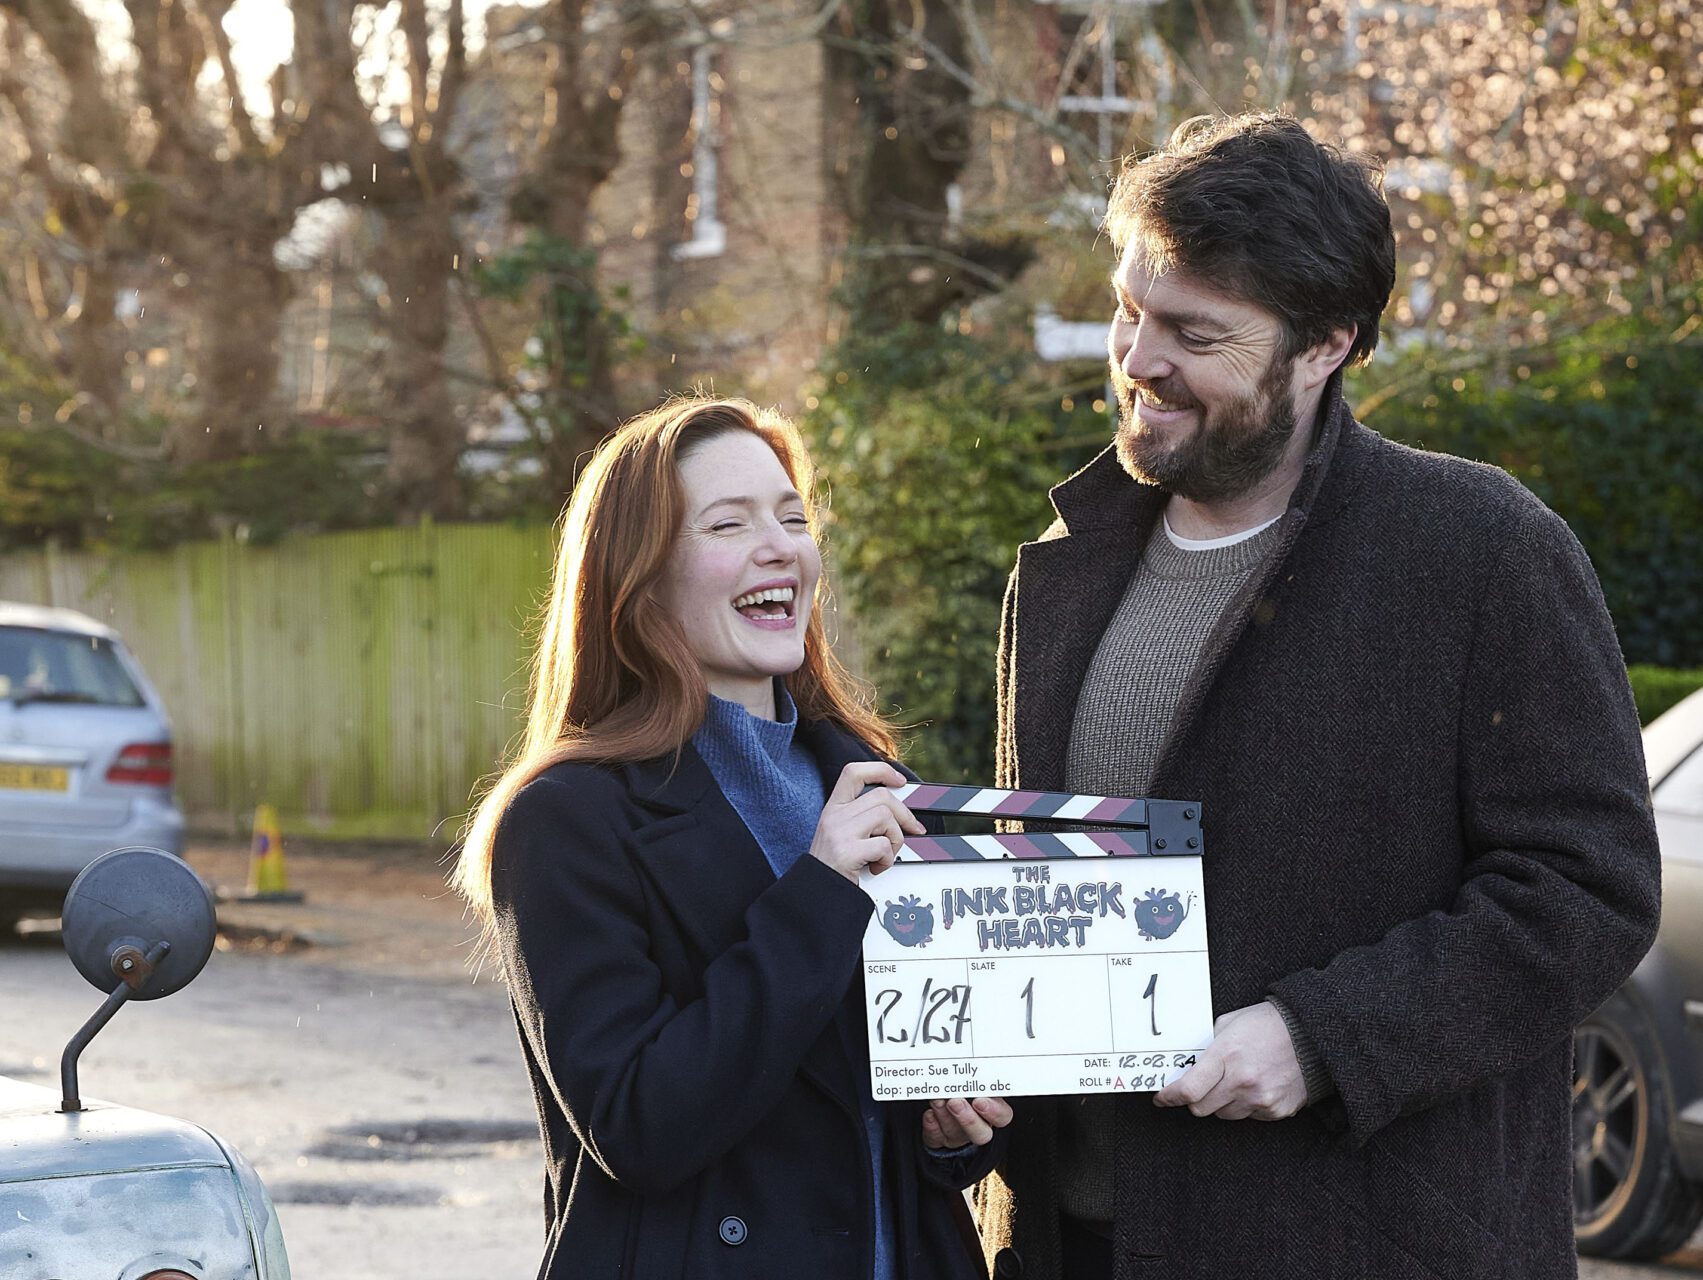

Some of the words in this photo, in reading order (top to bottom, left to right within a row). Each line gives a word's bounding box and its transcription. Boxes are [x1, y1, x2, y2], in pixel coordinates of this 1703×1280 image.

[1012, 865, 1050, 884] THE
[942, 887, 1009, 930] INK
[1013, 882, 1126, 919] BLACK
[977, 916, 1093, 952] HEART
[868, 965, 897, 974] SCENE
[971, 962, 996, 971] SLATE
[1111, 958, 1132, 966] TAKE
[875, 978, 972, 1047] 2/27
[1020, 977, 1036, 1039] 1
[1142, 974, 1162, 1036] 1
[875, 1066, 924, 1078] Director:
[928, 1065, 949, 1076] Sue
[952, 1063, 978, 1077] Tully
[1084, 1058, 1111, 1068] DATE:
[876, 1085, 902, 1098] dop:
[906, 1082, 940, 1097] pedro
[944, 1080, 986, 1093] cardillo
[990, 1079, 1011, 1091] abc
[1079, 1078, 1102, 1087] ROLL
